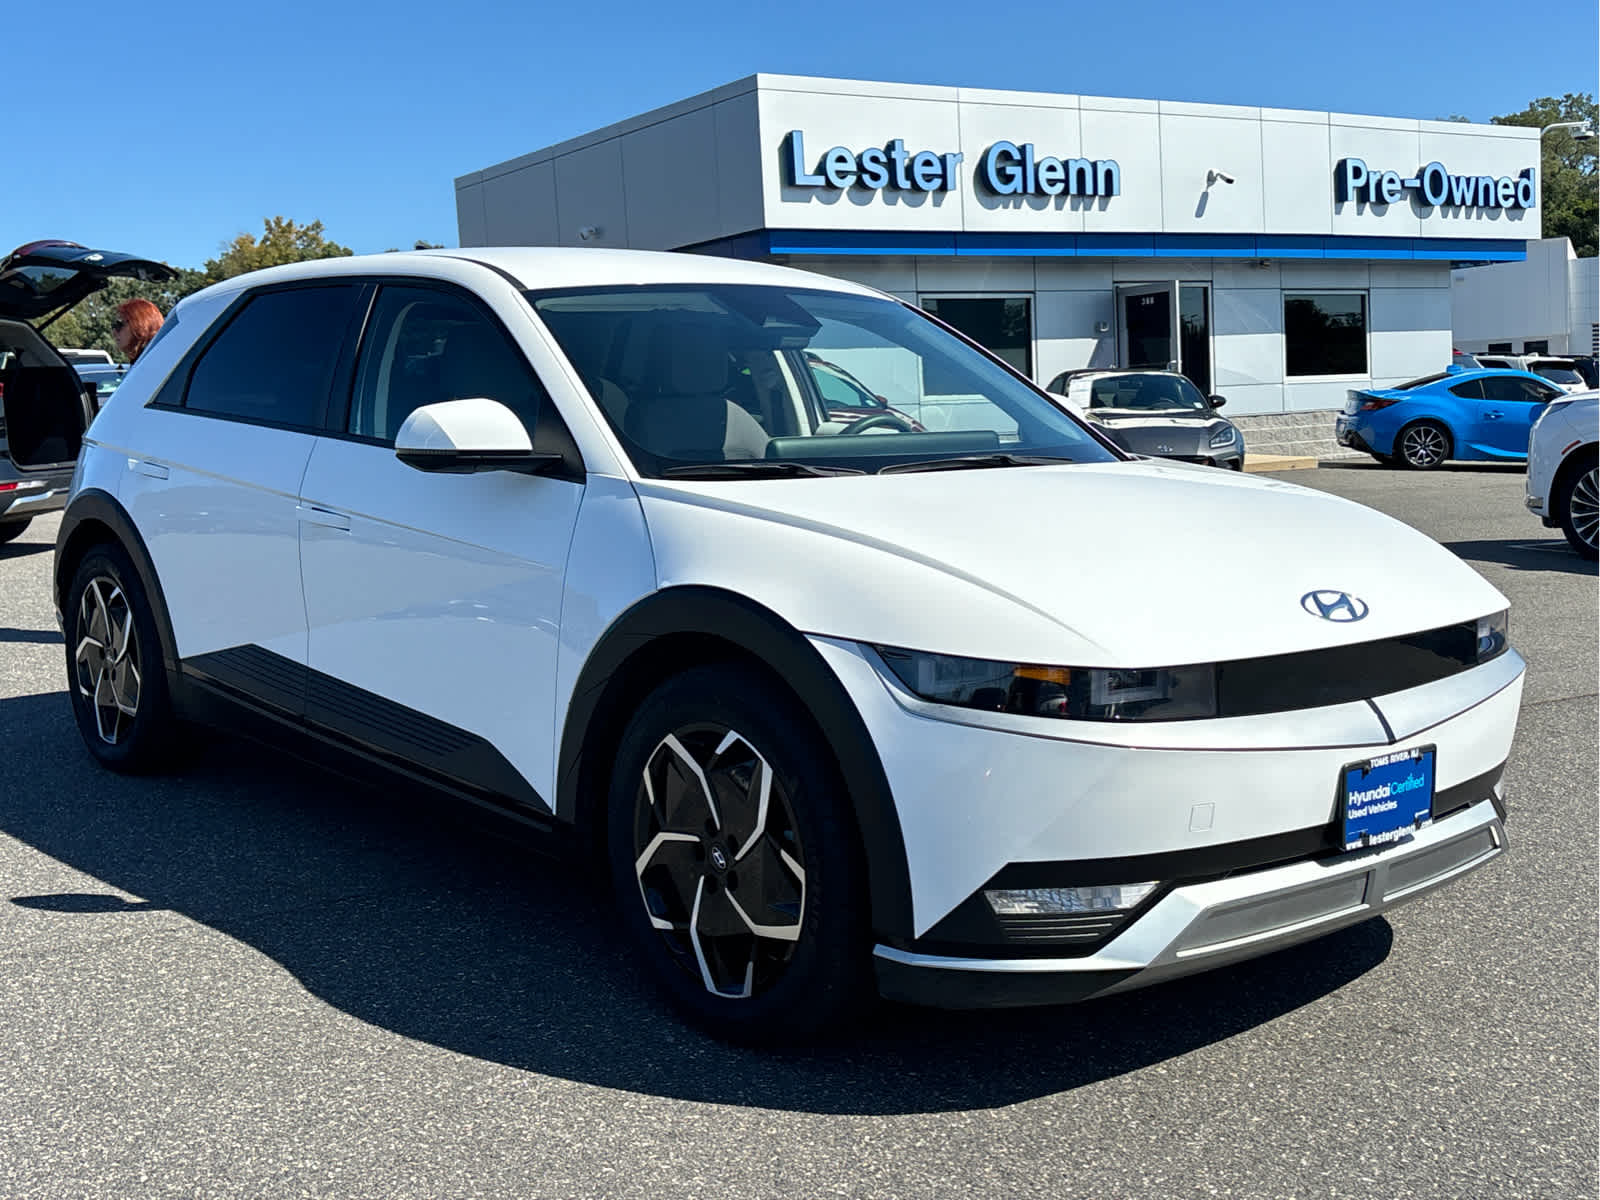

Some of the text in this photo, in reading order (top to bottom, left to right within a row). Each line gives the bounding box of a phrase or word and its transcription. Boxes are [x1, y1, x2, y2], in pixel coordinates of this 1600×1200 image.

[784, 130, 1121, 197] Lester Glenn
[1341, 158, 1536, 209] Pre-Owned
[1370, 756, 1389, 768] TOMS
[1410, 748, 1419, 759] NJ
[1348, 800, 1398, 819] Used Vehicles
